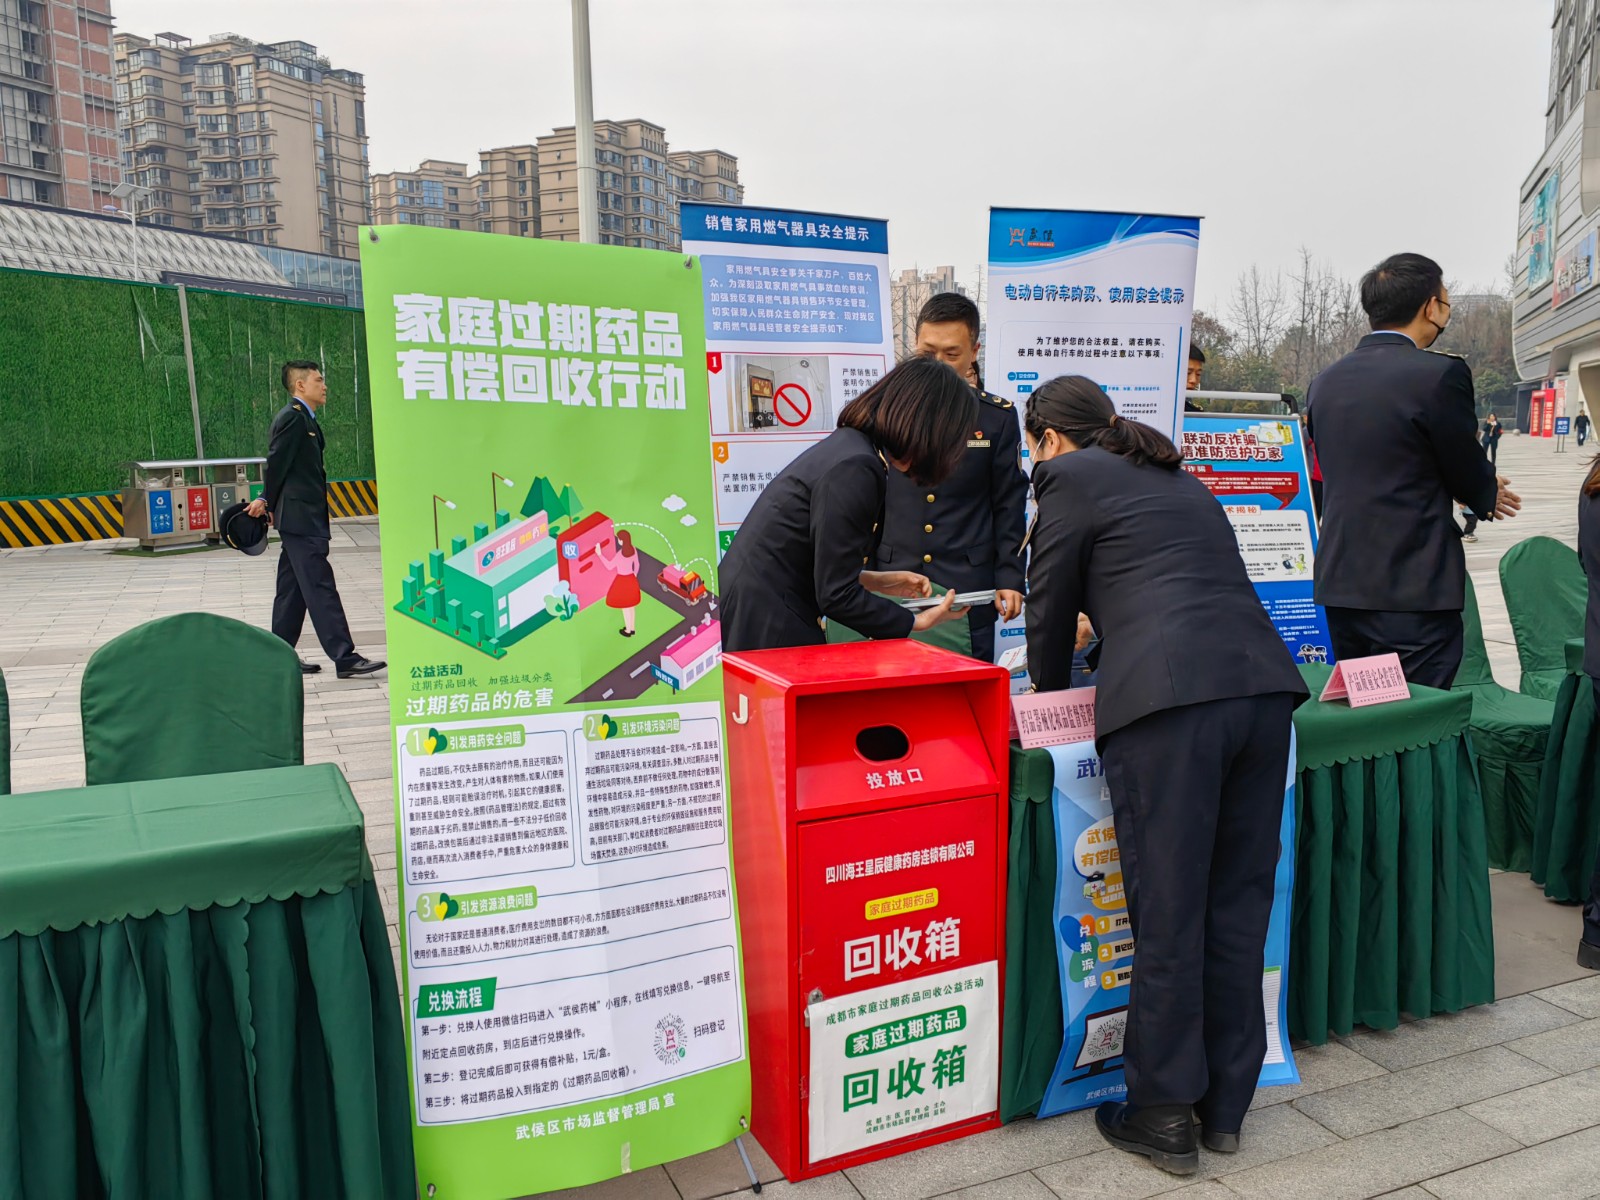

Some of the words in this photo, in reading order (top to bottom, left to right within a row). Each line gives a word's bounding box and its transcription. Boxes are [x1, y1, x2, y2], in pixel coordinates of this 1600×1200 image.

[705, 214, 869, 242] 销售家用燃气器具安全提示
[1005, 283, 1184, 304] 电动自行车购买、使用安全提示
[393, 293, 683, 357] 家庭过期药品
[712, 356, 718, 367] 1
[842, 367, 878, 376] 严禁销售国
[397, 349, 687, 410] 有偿回收行动
[1183, 432, 1257, 446] 联动反诈骗
[718, 446, 724, 457] 2
[724, 483, 769, 493] 装置的家用
[564, 544, 578, 557] 收
[724, 534, 732, 546] 3
[410, 664, 463, 678] 公益活动
[411, 676, 478, 692] 过期药品回收
[488, 671, 553, 685] 加强垃圾分类
[406, 686, 554, 717] 过期药品的危害
[587, 716, 596, 738] 2
[622, 718, 680, 736] 引发环境污染问题
[1020, 702, 1095, 735] 药品器械化妆品监督管理
[412, 730, 420, 752] 1
[450, 731, 522, 750] 引发用药安全问题
[865, 768, 923, 790] 投放口
[1076, 758, 1106, 780] 武
[826, 840, 974, 884] 四川海王星辰健康药房连锁有限公司
[422, 895, 431, 918] 3
[461, 892, 534, 915] 引发资源浪费问题
[870, 892, 936, 916] 家庭过期药品
[1100, 920, 1106, 930] 1
[1116, 917, 1131, 926] 打开
[844, 917, 961, 982] 回收箱
[1080, 924, 1098, 988] 兑换流程
[1102, 948, 1108, 957] 2
[1114, 942, 1136, 954] 登记过
[1105, 975, 1112, 984] 3
[428, 986, 483, 1012] 兑换流程
[826, 977, 984, 1026] 成都市家庭过期药品回收公益活动
[694, 1020, 726, 1038] 扫码登记
[852, 1012, 961, 1054] 家庭过期药品
[843, 1044, 967, 1112] 回收箱
[516, 1096, 660, 1140] 武侯区市场监督管理局
[664, 1092, 676, 1108] 宣
